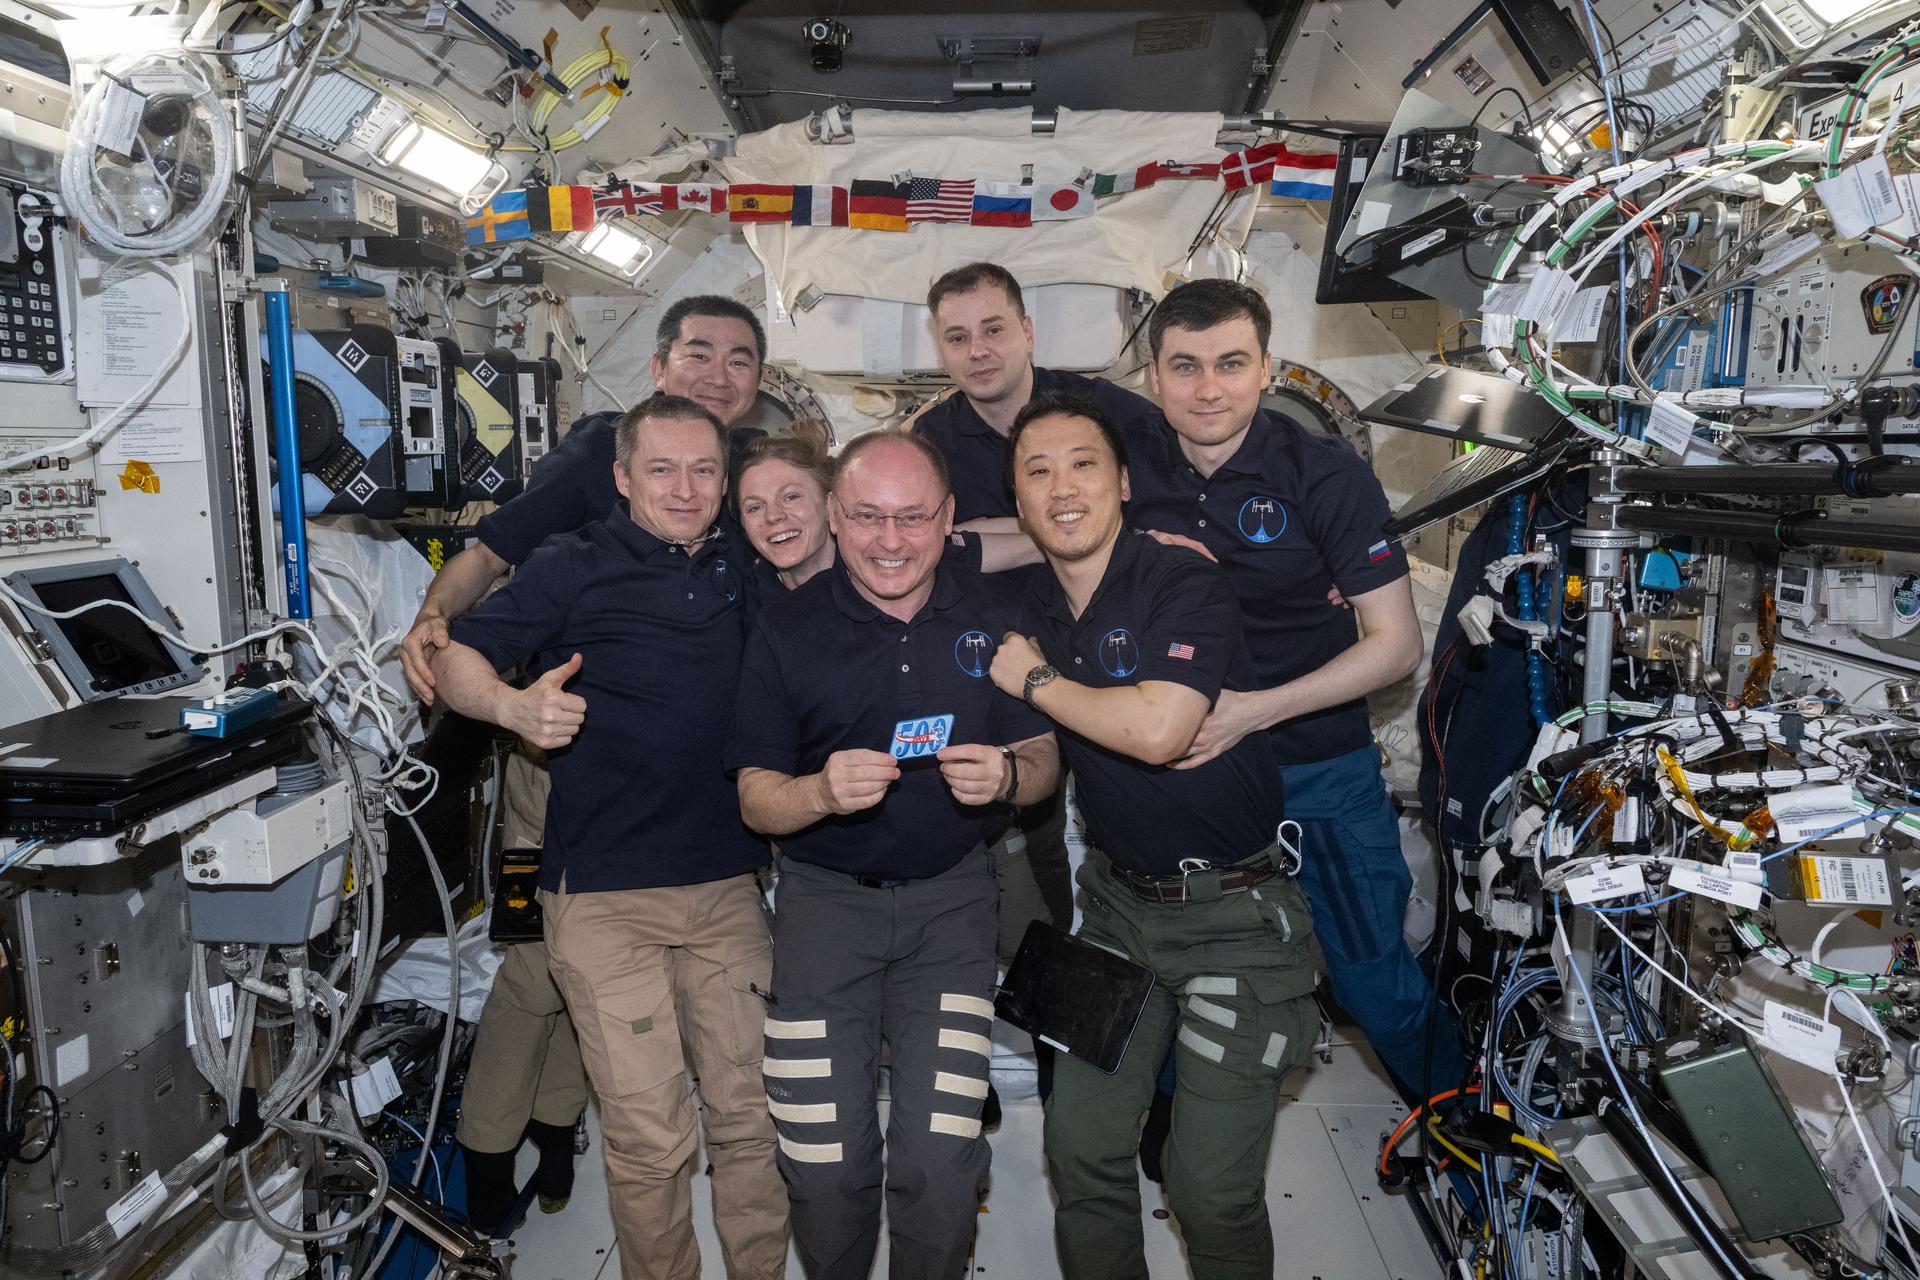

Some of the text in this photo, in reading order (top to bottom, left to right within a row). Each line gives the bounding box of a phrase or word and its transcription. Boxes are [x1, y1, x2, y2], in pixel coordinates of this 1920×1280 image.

[1893, 82, 1904, 104] 4
[1700, 876, 1732, 888] CONNECTOR
[1709, 883, 1730, 891] LAPTOP
[1550, 1240, 1558, 1270] ATTENTION
